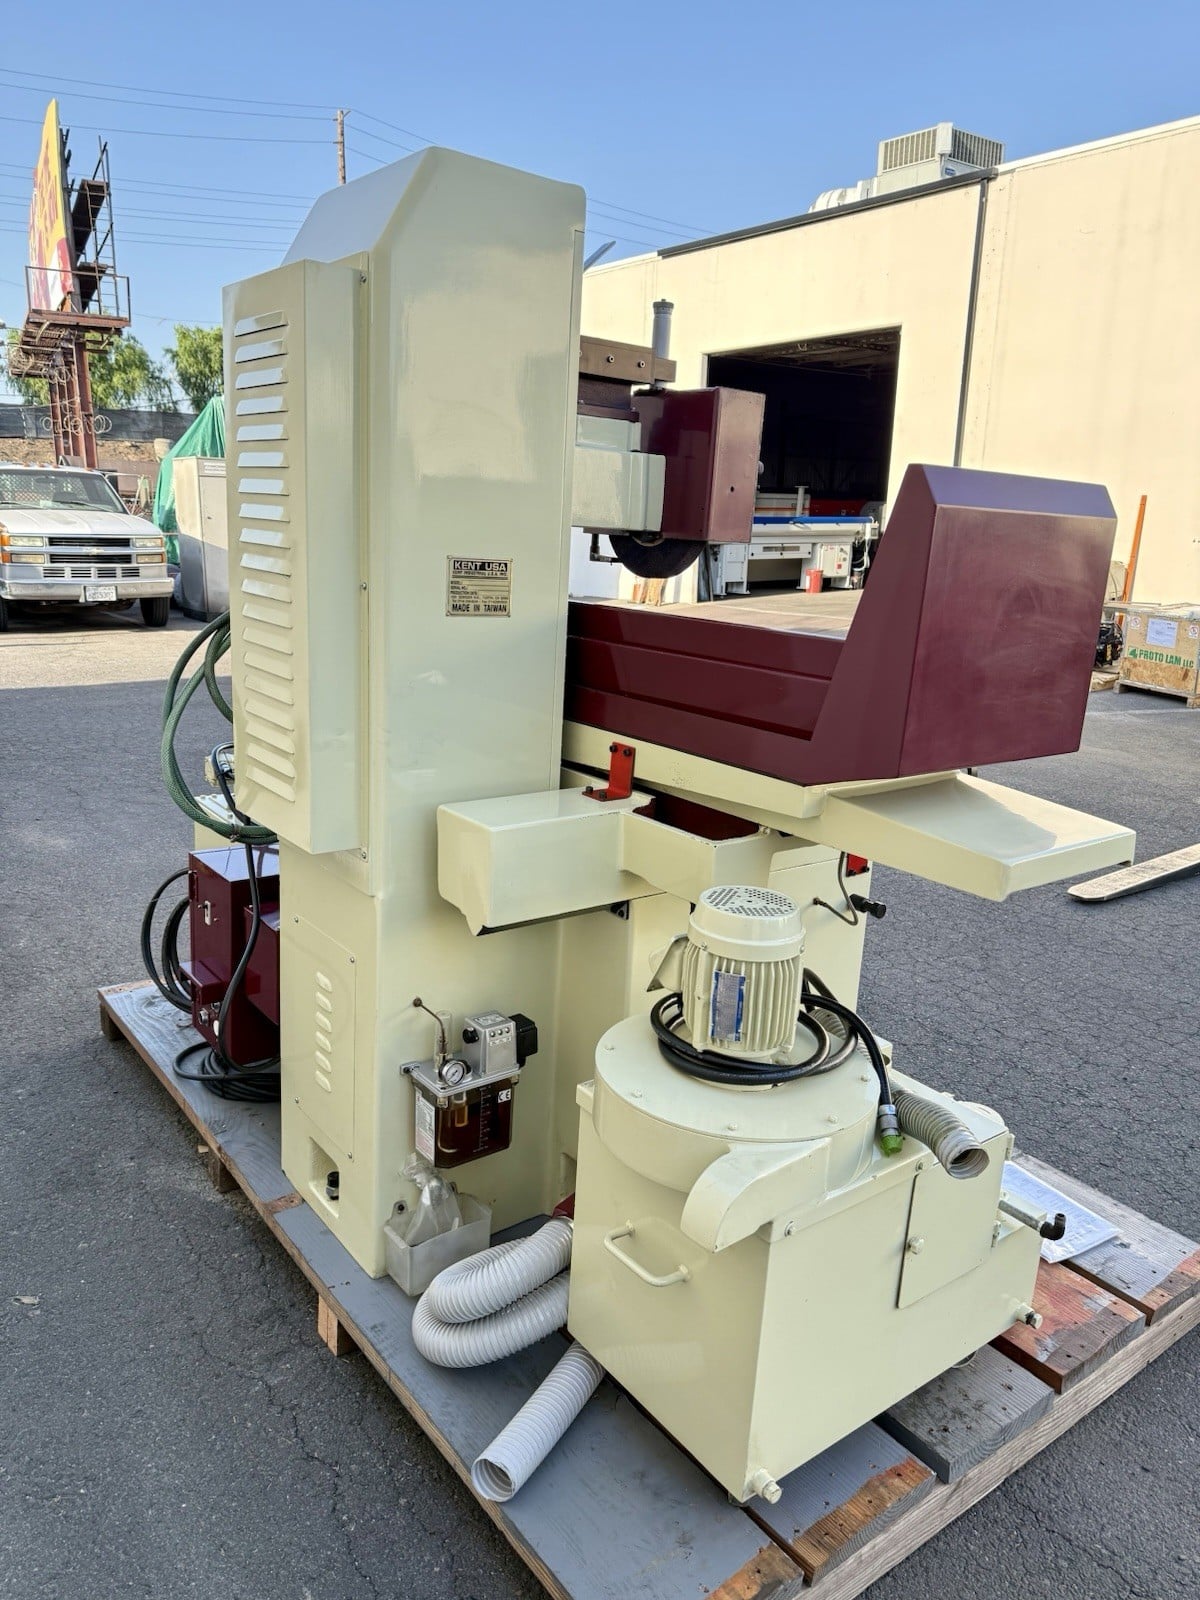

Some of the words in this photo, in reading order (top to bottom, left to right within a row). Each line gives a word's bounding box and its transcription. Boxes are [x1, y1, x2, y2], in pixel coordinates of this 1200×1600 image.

[454, 561, 481, 570] KENT
[485, 563, 506, 571] USA
[452, 604, 470, 612] MADE
[474, 604, 480, 612] IN
[483, 604, 507, 612] TAIWAN
[1138, 649, 1164, 662] PROTO
[1165, 654, 1181, 666] LAM
[1182, 659, 1194, 668] LLC
